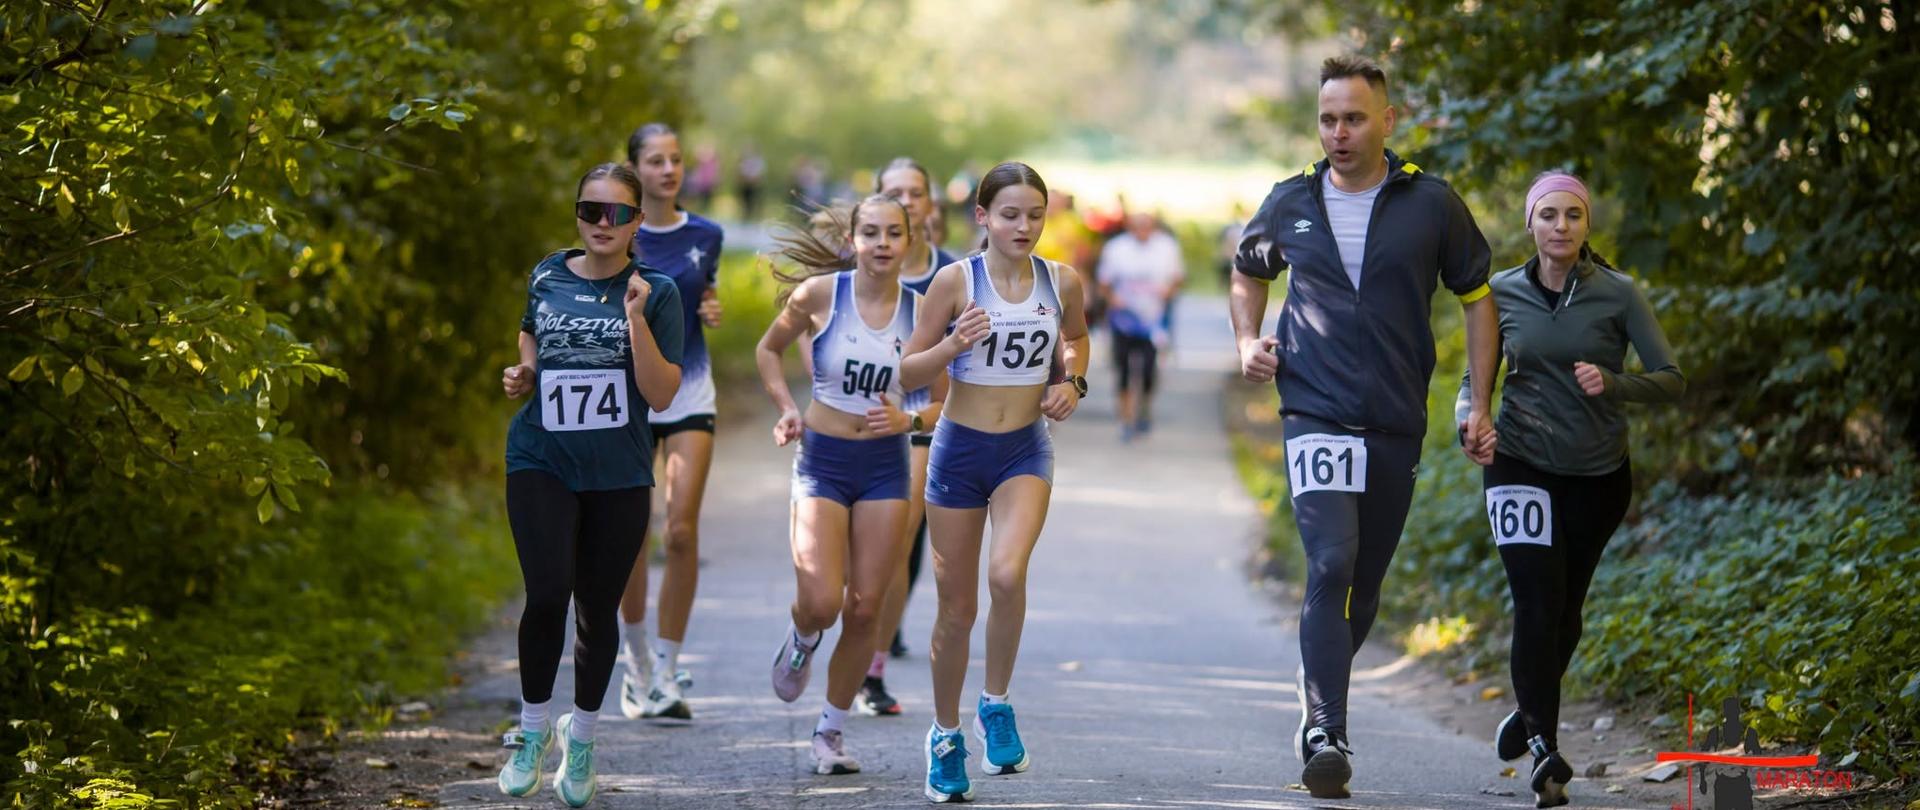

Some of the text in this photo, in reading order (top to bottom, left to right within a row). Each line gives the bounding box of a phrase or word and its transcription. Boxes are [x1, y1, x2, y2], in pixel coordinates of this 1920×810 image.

[981, 330, 1050, 369] 152
[842, 358, 893, 399] 544
[548, 382, 621, 425] 174
[1294, 447, 1353, 488] 161
[1490, 499, 1544, 540] 160
